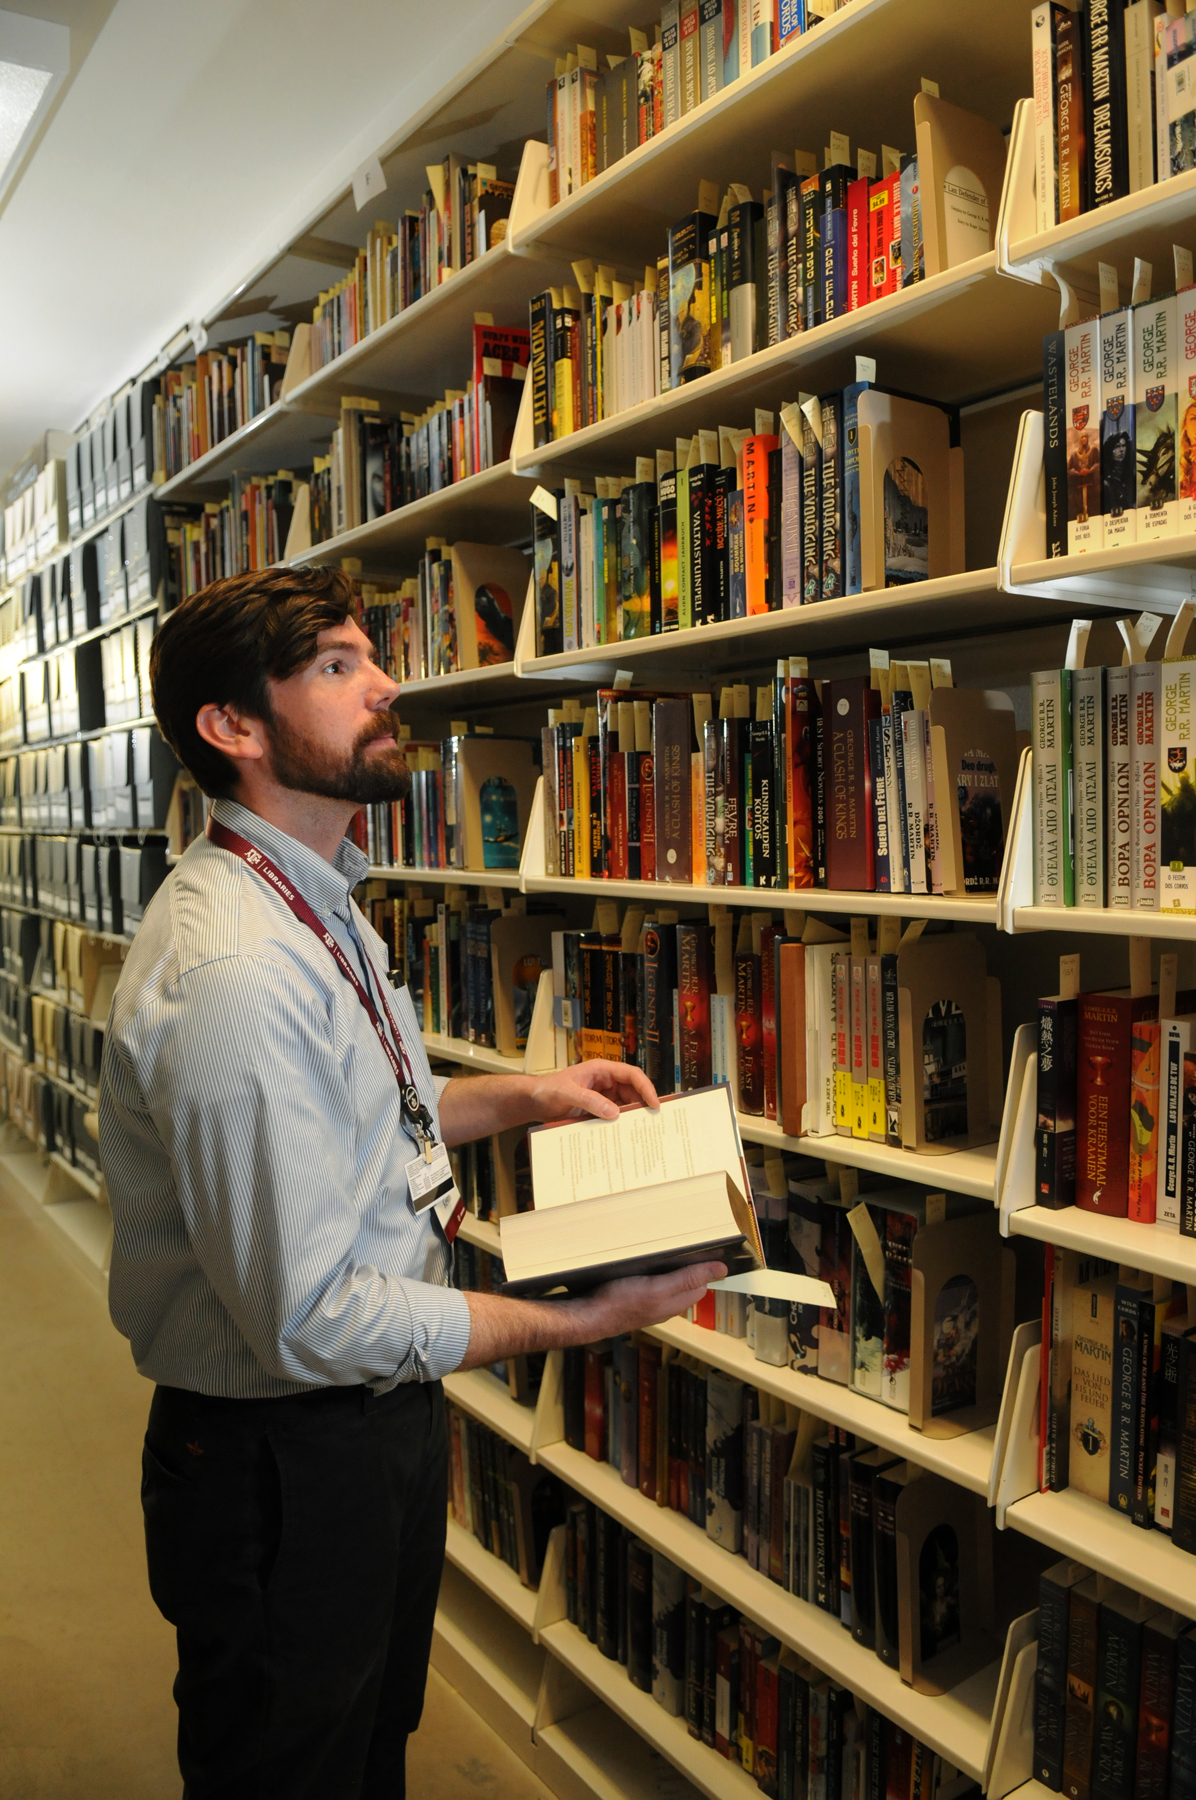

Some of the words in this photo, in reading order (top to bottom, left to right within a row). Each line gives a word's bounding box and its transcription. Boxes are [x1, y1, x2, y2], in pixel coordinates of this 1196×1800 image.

[1041, 48, 1050, 101] CORBEAUX
[1092, 46, 1110, 102] MARTIN
[1036, 114, 1042, 126] UN
[1042, 101, 1050, 118] LES
[1060, 84, 1070, 133] GEORGE
[1093, 103, 1112, 194] DREAMSONGS
[958, 187, 980, 200] Defender
[1062, 162, 1070, 209] MARTIN
[482, 342, 520, 362] ACES
[1116, 322, 1126, 364] MARTIN
[1143, 324, 1154, 372] GEORGE
[1156, 310, 1166, 354] MARTIN
[1185, 310, 1196, 360] GEORGE
[532, 320, 546, 425] MONOLITH
[1069, 346, 1079, 393] GEORGE
[1080, 332, 1091, 374] MARTIN
[1104, 336, 1114, 384] GEORGE
[1048, 340, 1058, 448] WASTELANDS
[694, 511, 702, 612] VALTAISTUINPELI
[1166, 683, 1176, 732] GEORGE
[1179, 672, 1190, 714] MARTIN
[816, 717, 825, 738] BEST
[1087, 695, 1095, 746] MARTIN
[1119, 694, 1128, 746] MARTIN
[1145, 691, 1153, 745] MARTIN
[672, 744, 680, 776] KINGS
[834, 743, 845, 781] CLASH
[846, 730, 857, 772] GEORGE
[894, 744, 904, 769] TWIN
[961, 759, 974, 770] Deo
[672, 779, 680, 792] OF
[816, 772, 825, 804] NOVELS
[836, 785, 846, 800] OF
[875, 776, 886, 806] FEVRE
[974, 775, 978, 786] I
[1045, 764, 1057, 806] ΑΤΣΑΛΙ
[1086, 762, 1097, 804] ΑΤΣΑΛΙ
[1117, 762, 1129, 834] ΟΡΝΙΩΝ
[1143, 761, 1155, 834] ΟΡΝΙΩΝ
[642, 783, 654, 833] LEGENDS
[672, 795, 680, 829] CLASH
[706, 795, 716, 856] VOYAGING
[728, 798, 737, 837] FEVRE
[754, 798, 762, 840] KOITOS
[761, 779, 770, 858] KUNINKAIDEN
[816, 806, 824, 824] 2005
[836, 803, 848, 839] KINGS
[848, 798, 857, 838] MARTIN
[876, 806, 886, 821] DEL
[1046, 809, 1057, 836] ΑΠΟ
[1086, 808, 1097, 834] ΑΠΟ
[262, 866, 295, 901] LIBRARIES
[1046, 840, 1058, 886] ΘΥΕΛΛΑ
[1086, 840, 1097, 886] ΘΥΕΛΛΑ
[1118, 841, 1129, 887] ΒΟΡΑ
[1143, 842, 1155, 889] ΒΟΡΑ
[336, 952, 358, 986] LIBRARIES
[682, 935, 691, 994] MARTIN
[690, 934, 698, 976] GEORGE
[646, 962, 659, 1029] LEGENDS
[738, 962, 746, 1016] MARTIN
[886, 991, 894, 1012] RIVER
[1084, 1012, 1118, 1022] MARTIN
[886, 1030, 895, 1048] DEAD
[690, 1041, 698, 1082] FEAST
[1169, 1062, 1178, 1075] TUF
[1169, 1077, 1177, 1085] DE
[1088, 1094, 1098, 1126] VOOR
[1098, 1095, 1109, 1118] EEN
[1169, 1085, 1177, 1105] VIAJES
[1169, 1107, 1177, 1123] LOS
[1087, 1129, 1097, 1180] KRAAIEN
[1096, 1121, 1108, 1187] FEESTMAAL
[1168, 1134, 1176, 1156] Martin
[1187, 1140, 1195, 1174] GEORGE
[1167, 1170, 1176, 1192] George
[1185, 1196, 1194, 1231] MARTIN
[1118, 1306, 1136, 1315] CARDS
[1121, 1300, 1137, 1308] WILD
[1075, 1340, 1112, 1365] MARTIN
[1164, 1343, 1178, 1384] 光之逝
[1074, 1366, 1090, 1378] DAS
[1092, 1372, 1110, 1386] LIED
[1075, 1384, 1086, 1394] EIS
[1088, 1388, 1108, 1402] UND
[1082, 1377, 1101, 1391] VON
[1121, 1348, 1133, 1399] GEORGE
[1080, 1394, 1105, 1410] FEUER
[1121, 1415, 1131, 1425] R.
[1088, 1435, 1094, 1451] 1
[1120, 1429, 1130, 1479] MARTIN
[1041, 1601, 1053, 1656] MARTIN
[1106, 1630, 1120, 1691] MARTIN
[1144, 1648, 1160, 1710] MARTIN
[1175, 1656, 1195, 1744] MARTIN
[1099, 1721, 1113, 1781] SWORDS
